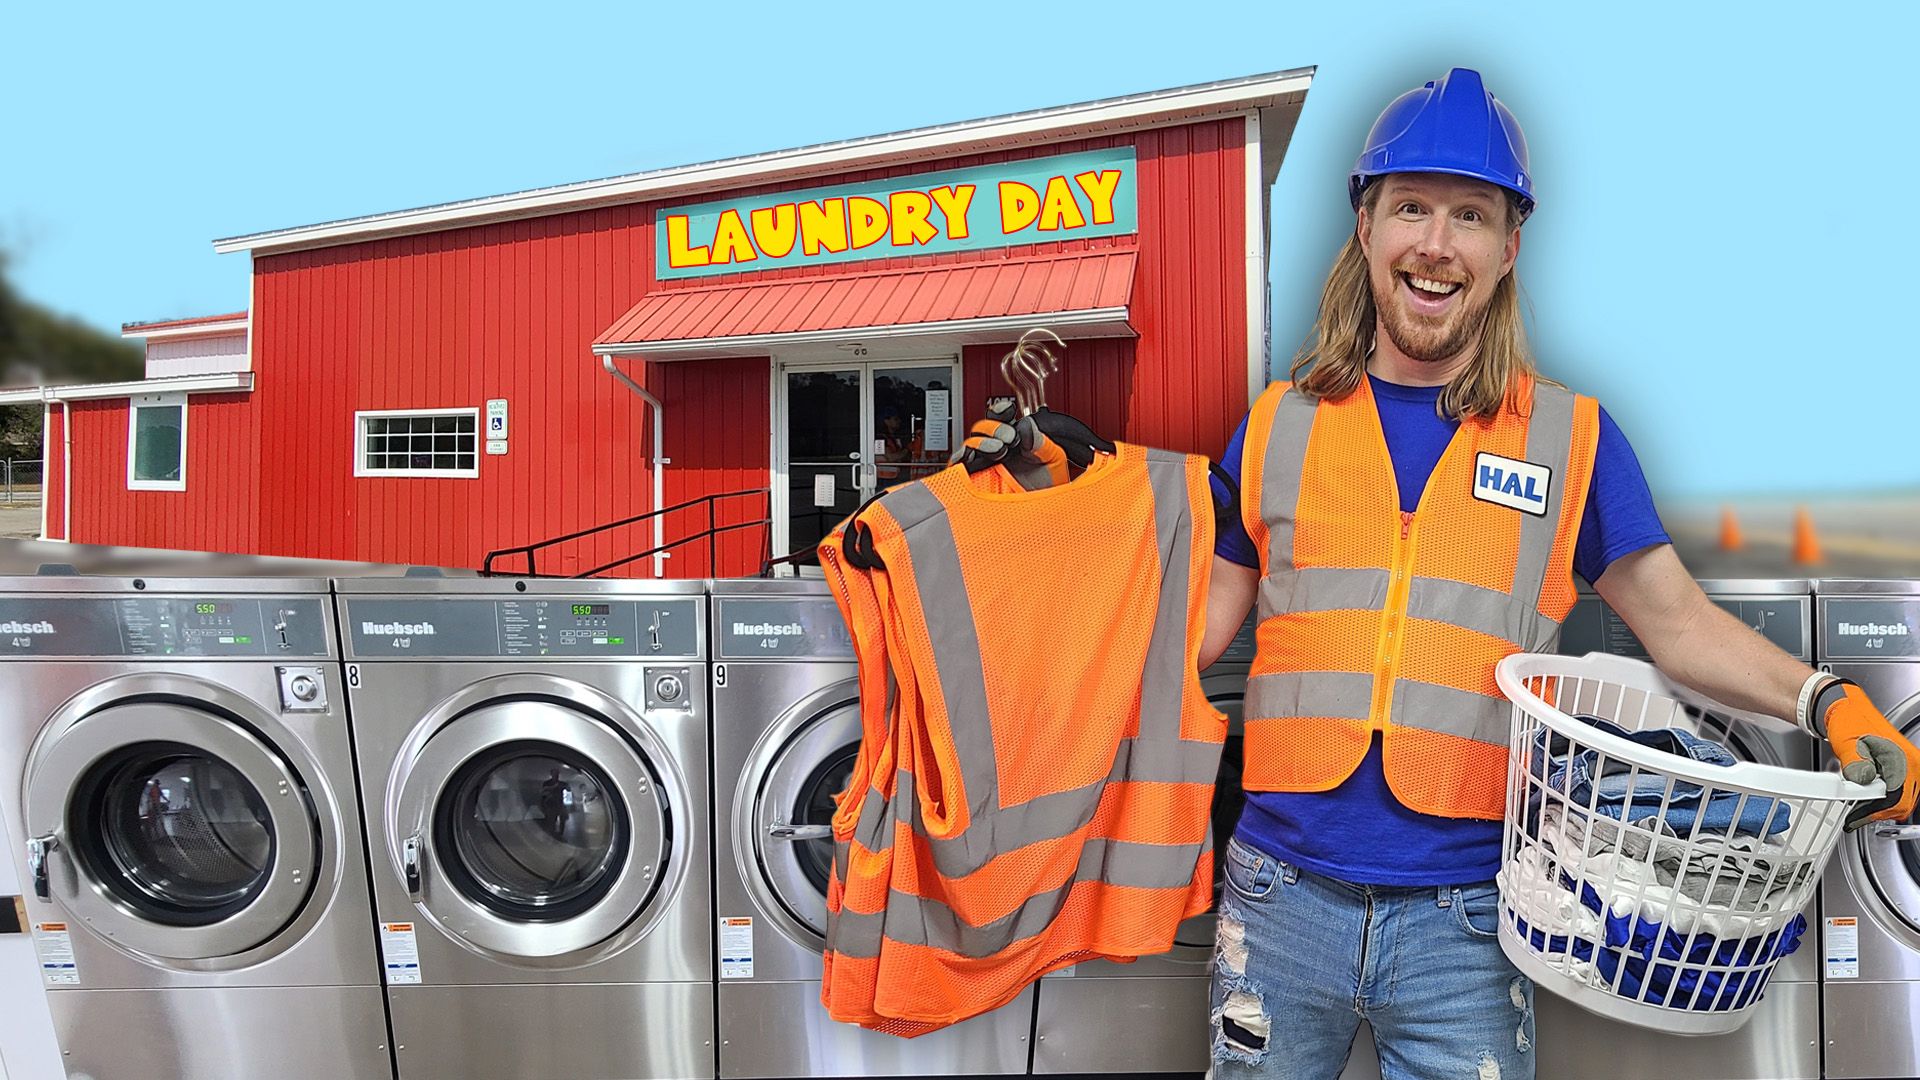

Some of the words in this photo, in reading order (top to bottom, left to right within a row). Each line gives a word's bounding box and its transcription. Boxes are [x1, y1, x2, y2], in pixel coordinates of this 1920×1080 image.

[666, 184, 976, 268] LAUNDRY
[998, 169, 1122, 235] DAY
[1480, 465, 1543, 503] HAL
[0, 620, 54, 634] ebsch
[362, 621, 434, 635] Huebsch
[733, 622, 802, 635] Huebsch
[1838, 622, 1908, 635] Huebsch
[392, 637, 400, 648] 4
[760, 638, 767, 648] 4
[1865, 639, 1872, 649] 4
[349, 665, 359, 686] 8
[716, 665, 726, 686] 9
